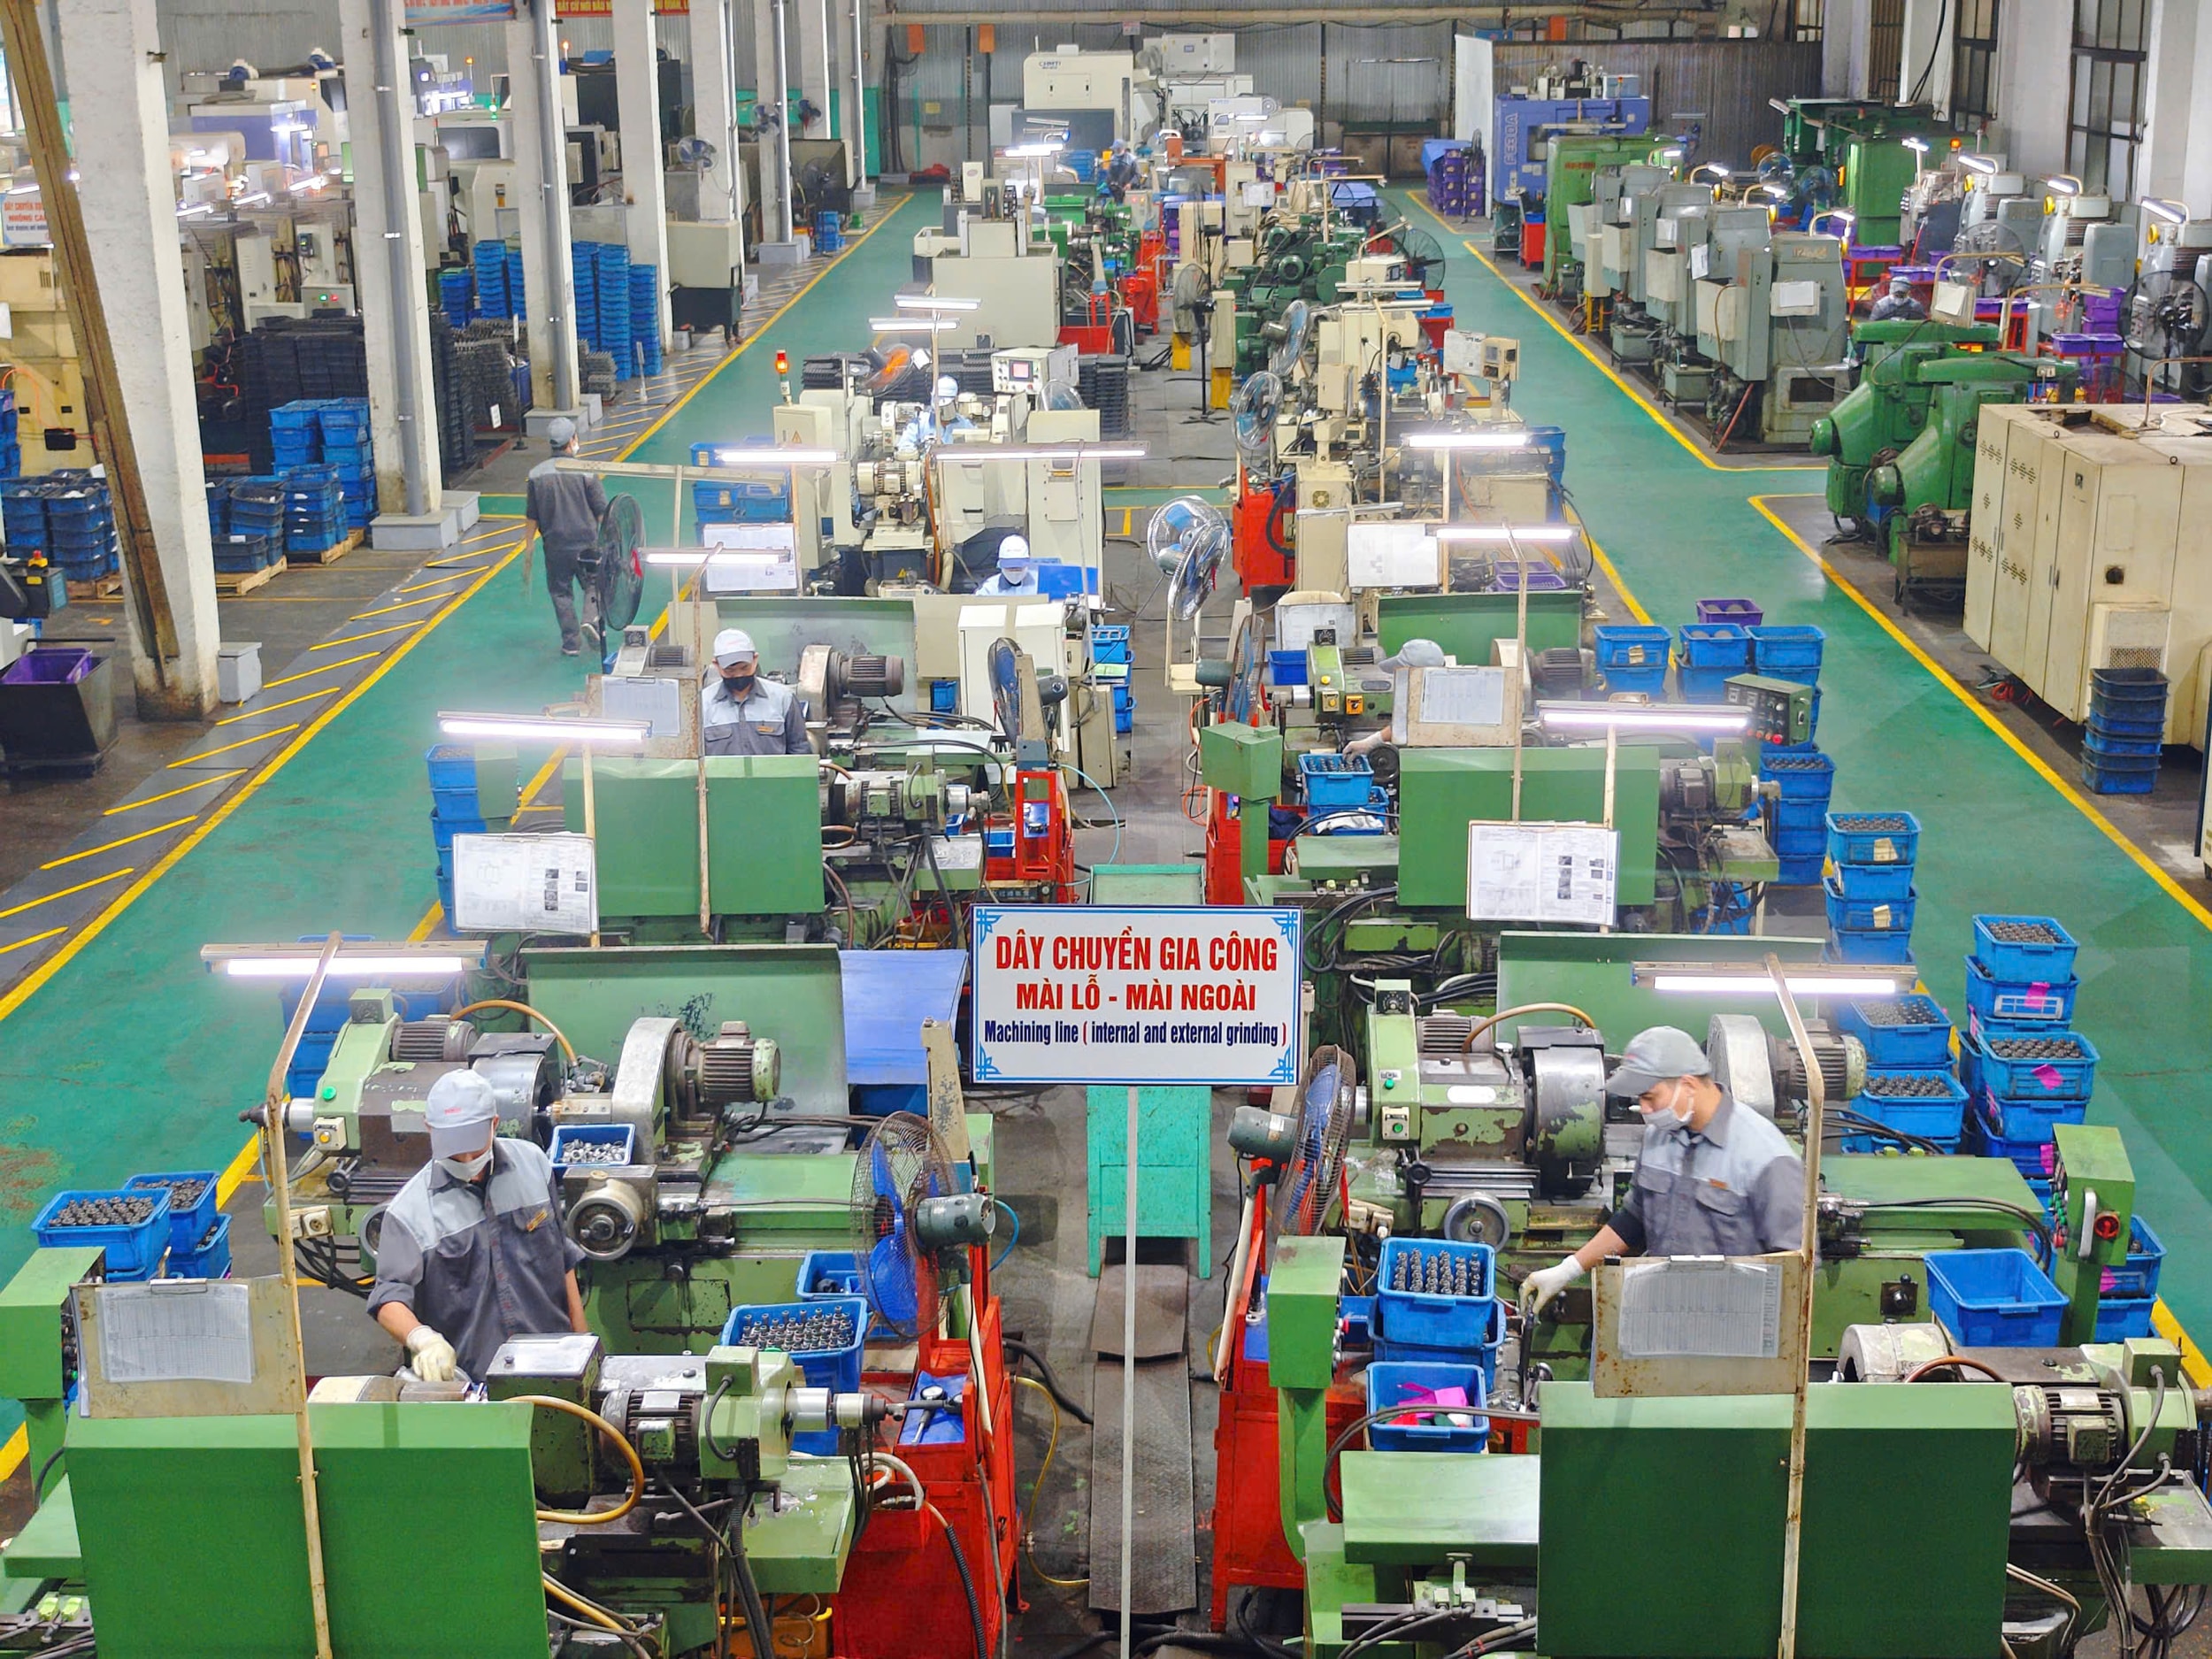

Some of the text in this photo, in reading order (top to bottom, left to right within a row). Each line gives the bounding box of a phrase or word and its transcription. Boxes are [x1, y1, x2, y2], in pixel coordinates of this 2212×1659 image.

[995, 926, 1278, 972] DÂY CHUYỀN GIA CÔNG
[1016, 978, 1063, 1010] MÀI
[1071, 974, 1100, 1010] LỖ
[1125, 983, 1172, 1010] MÀI
[1180, 980, 1256, 1011] NGOÀI
[984, 1020, 1050, 1045] Machining
[1055, 1020, 1079, 1043] line
[1091, 1021, 1140, 1044] internal
[1143, 1022, 1167, 1044] and
[1170, 1022, 1223, 1044] external
[1226, 1022, 1279, 1047] grinding
